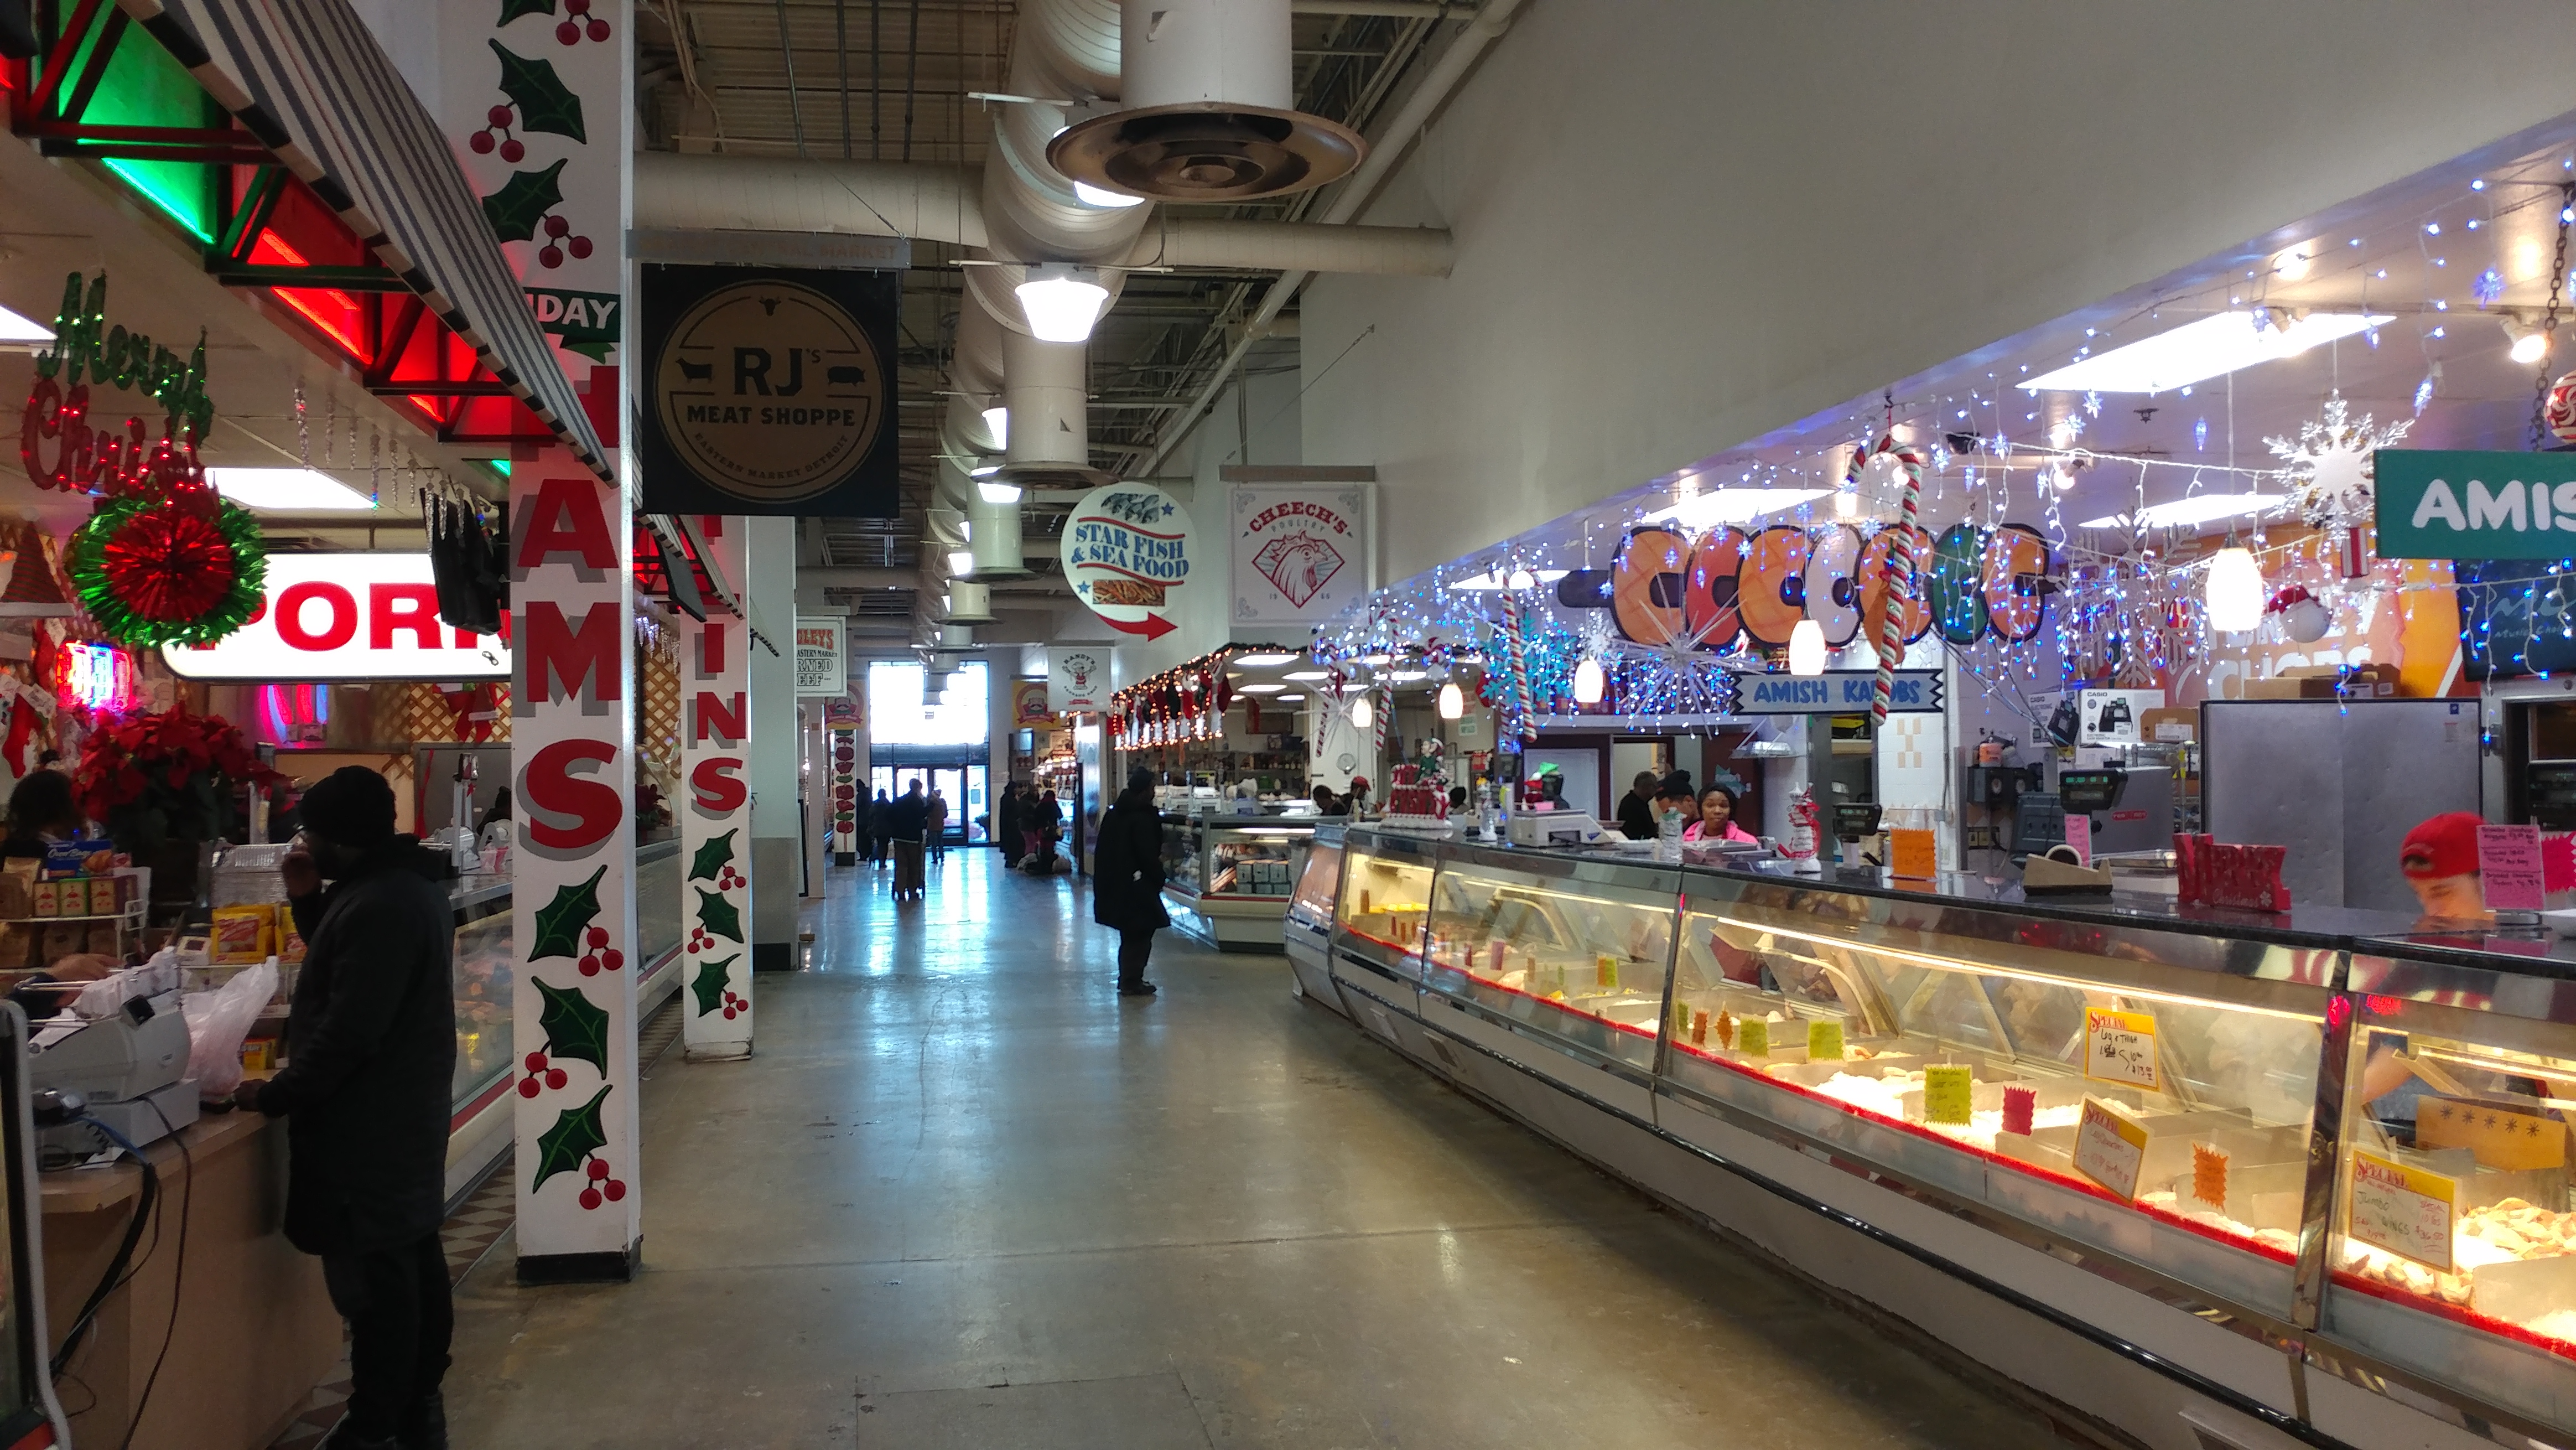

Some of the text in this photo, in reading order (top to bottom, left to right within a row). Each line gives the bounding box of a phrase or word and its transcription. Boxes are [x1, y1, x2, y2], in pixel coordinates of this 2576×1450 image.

[529, 293, 617, 330] DAY
[687, 405, 855, 427] MEAT SHOPPE
[694, 432, 849, 480] EASTERN MARKET DETROIT
[1249, 501, 1348, 535] CHEECH'S
[2412, 479, 2576, 532] AMIS
[1076, 524, 1184, 558] STAR FISH
[1071, 544, 1189, 578] & SEA FOOD
[797, 649, 816, 657] ASTERN
[797, 658, 833, 672] RNED
[797, 673, 823, 687] EEF
[1753, 679, 1920, 705] AMISH KABS
[2089, 1011, 2128, 1033] SPECIAL
[2354, 1154, 2409, 1189] SPECIAL
